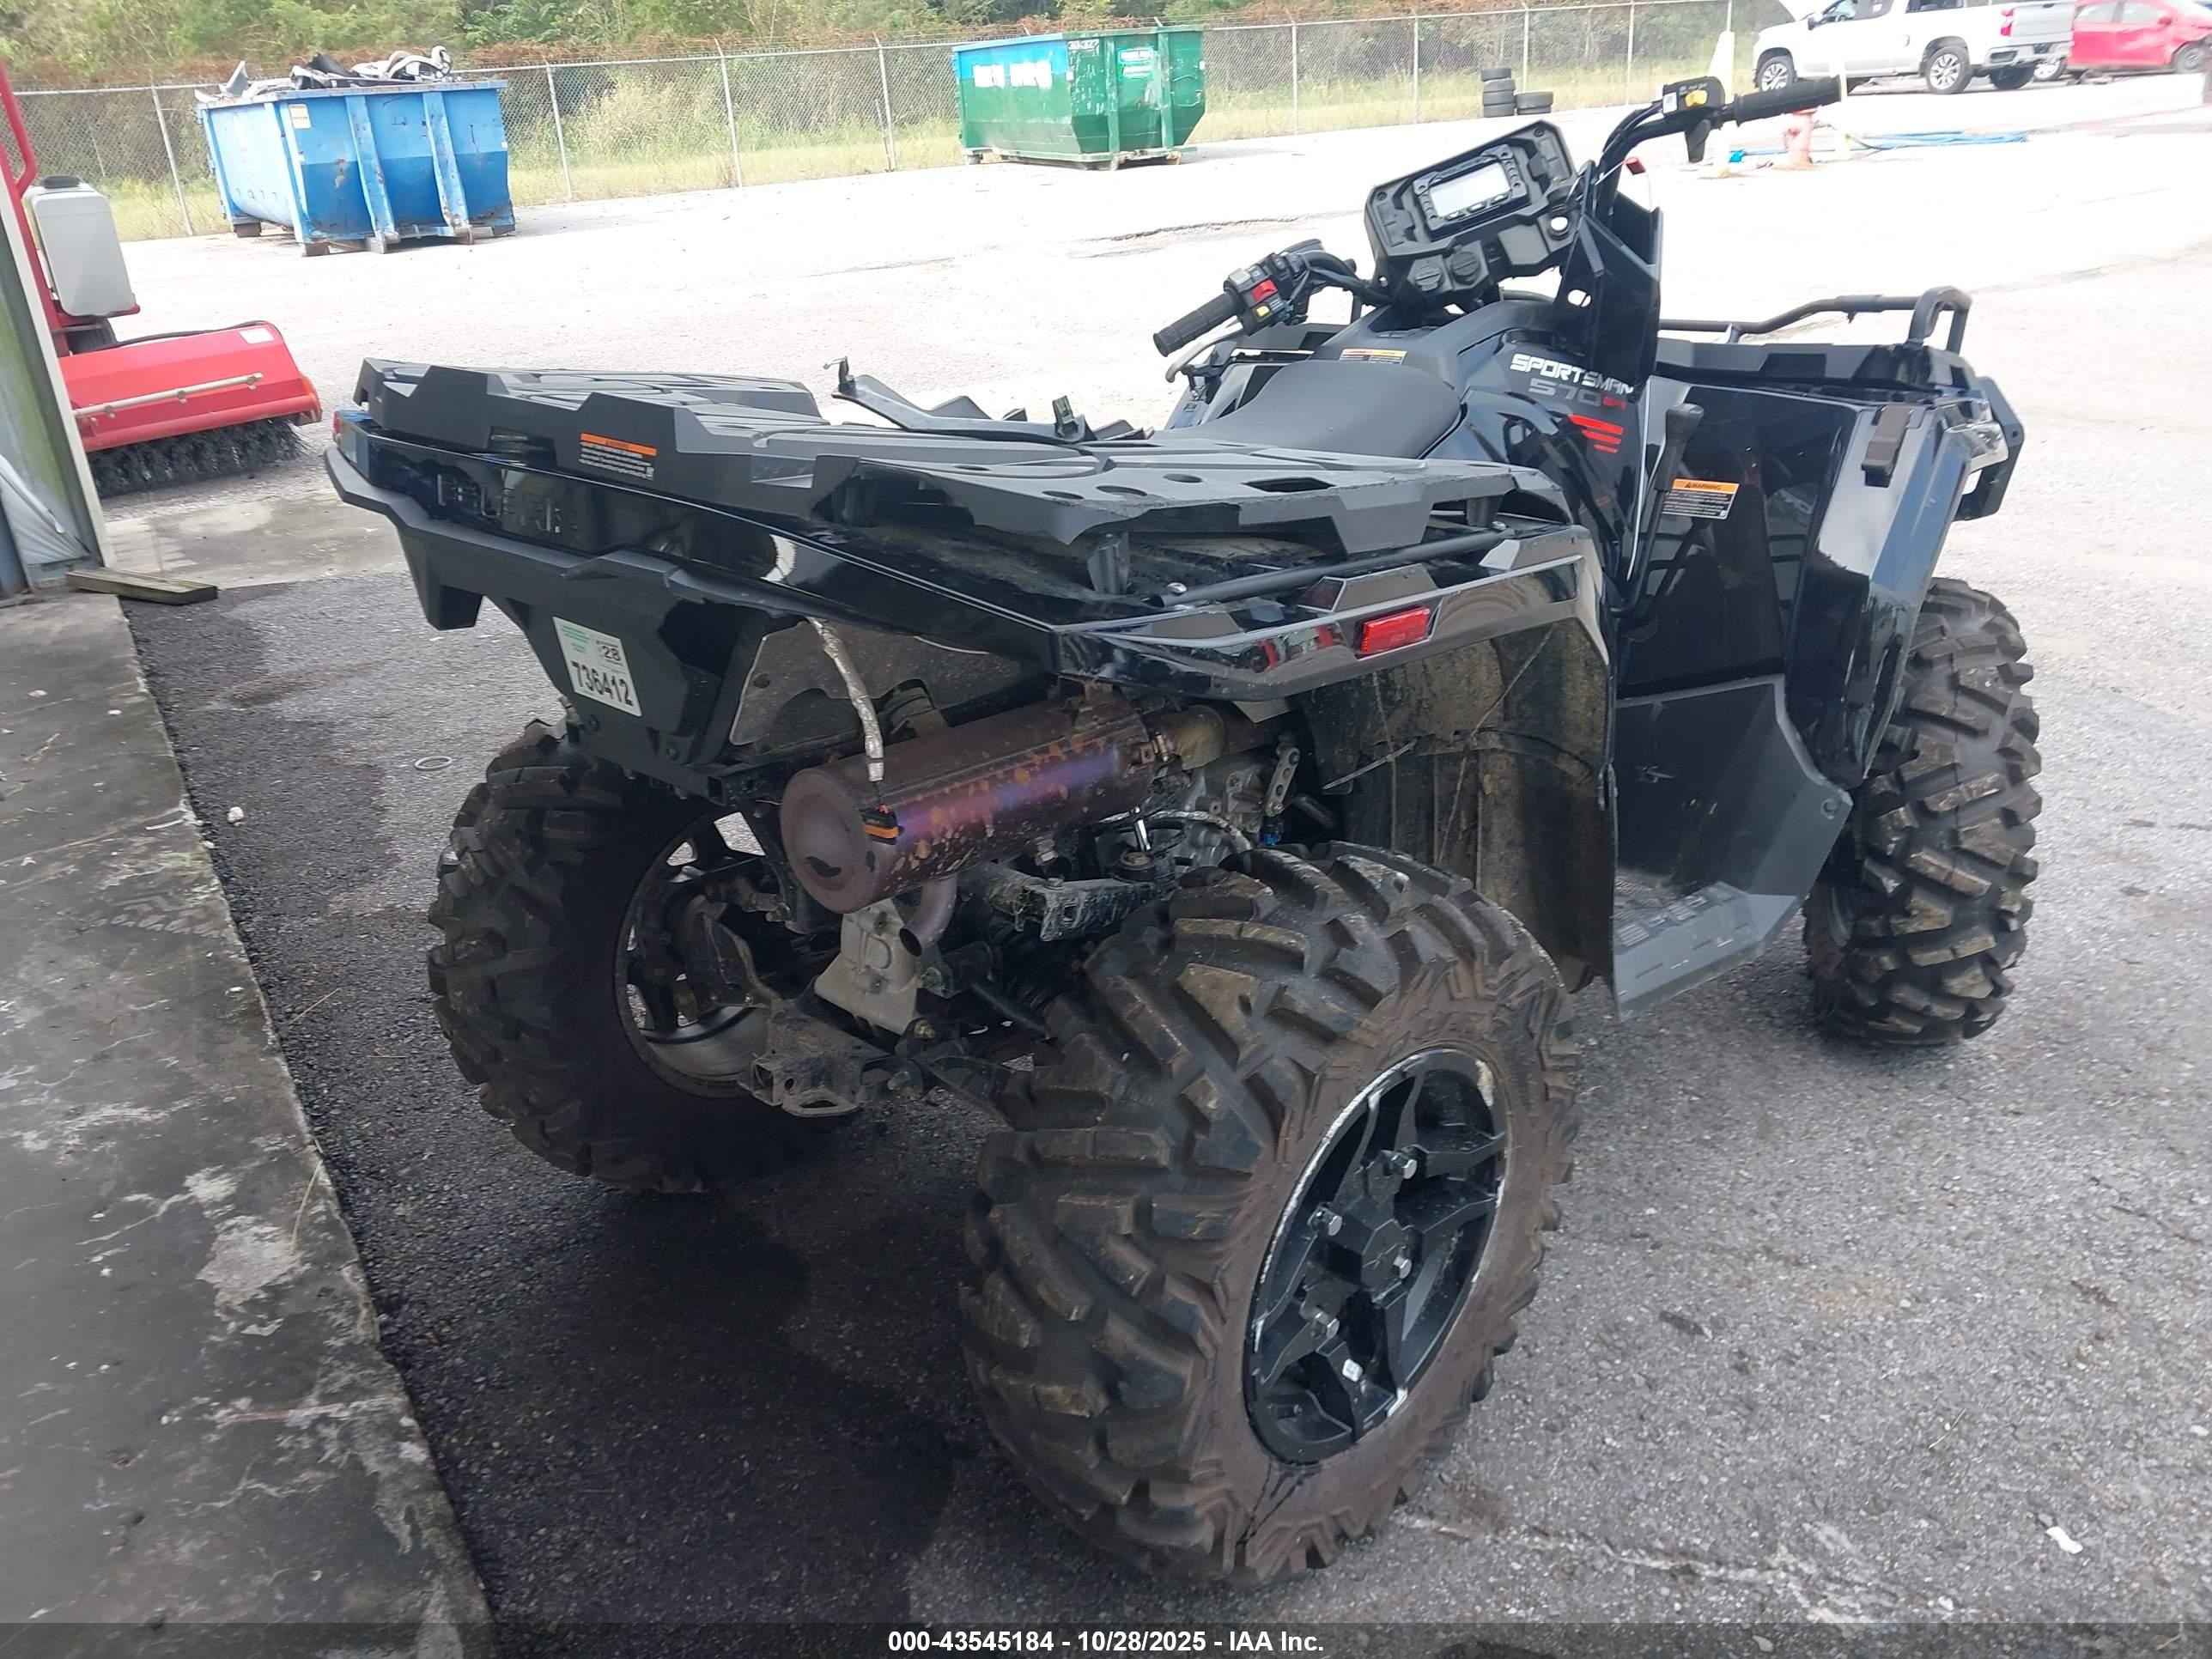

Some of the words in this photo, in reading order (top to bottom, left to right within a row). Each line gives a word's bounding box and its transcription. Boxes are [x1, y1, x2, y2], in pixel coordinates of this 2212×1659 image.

[1510, 353, 1634, 394] SPORTSMAN
[1528, 377, 1602, 407] 570
[601, 645, 622, 661] 28
[571, 660, 634, 707] 736412
